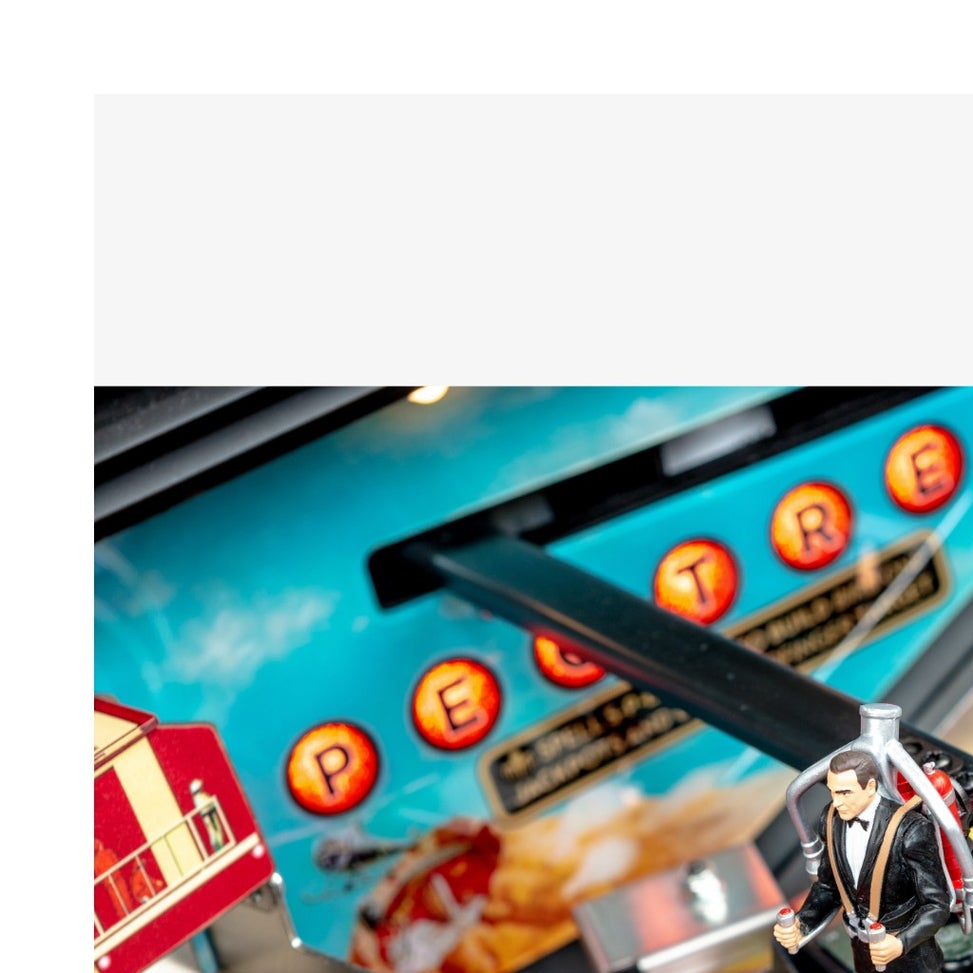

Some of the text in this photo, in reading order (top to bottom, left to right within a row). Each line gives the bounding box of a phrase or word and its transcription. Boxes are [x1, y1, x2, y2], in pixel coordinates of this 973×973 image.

[314, 443, 944, 796] P E T R E
